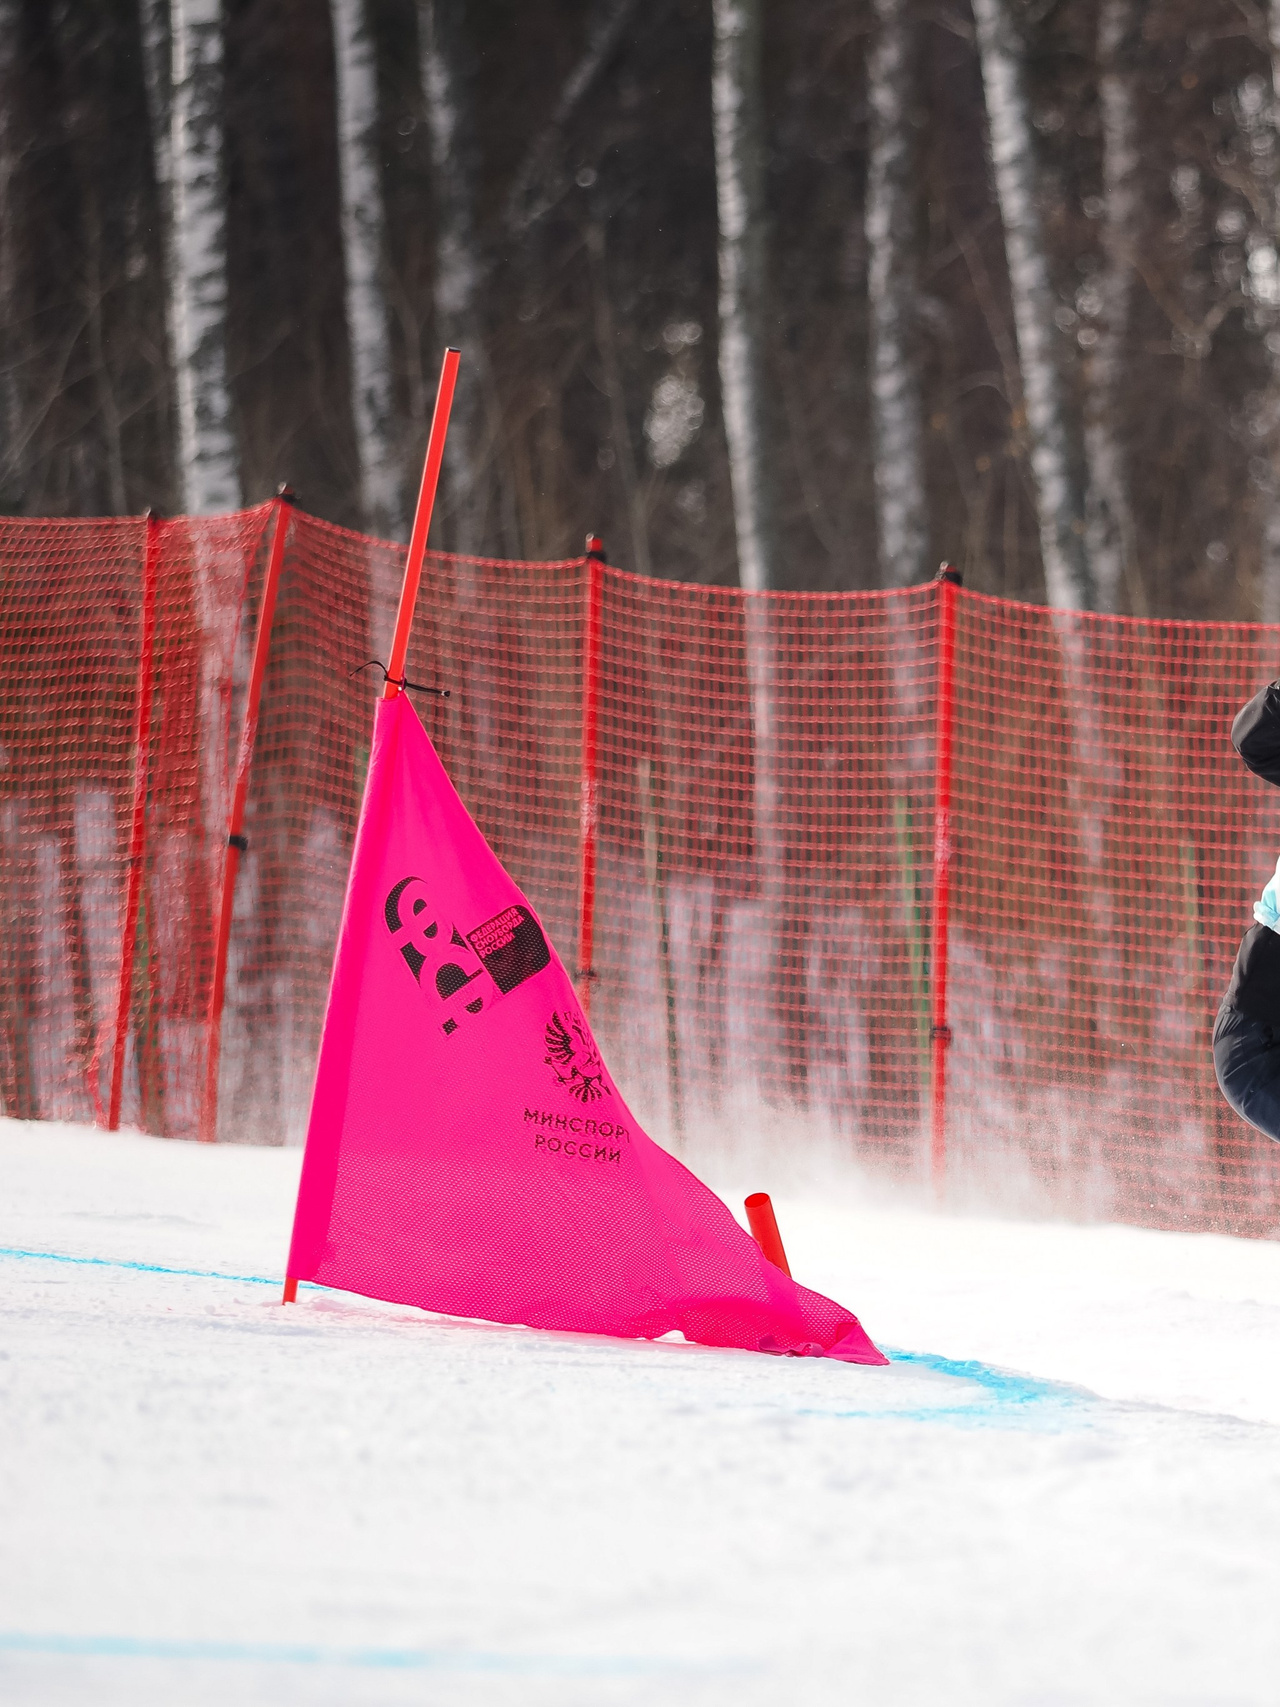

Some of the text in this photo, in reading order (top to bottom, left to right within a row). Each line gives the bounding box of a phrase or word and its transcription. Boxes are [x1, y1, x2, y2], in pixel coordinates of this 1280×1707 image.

[470, 907, 519, 942] ФЕДЕРАЦИЯ
[475, 914, 525, 950] СНОУБОРДА
[479, 931, 516, 959] РОССИИ
[534, 1134, 621, 1164] РОССИИ
